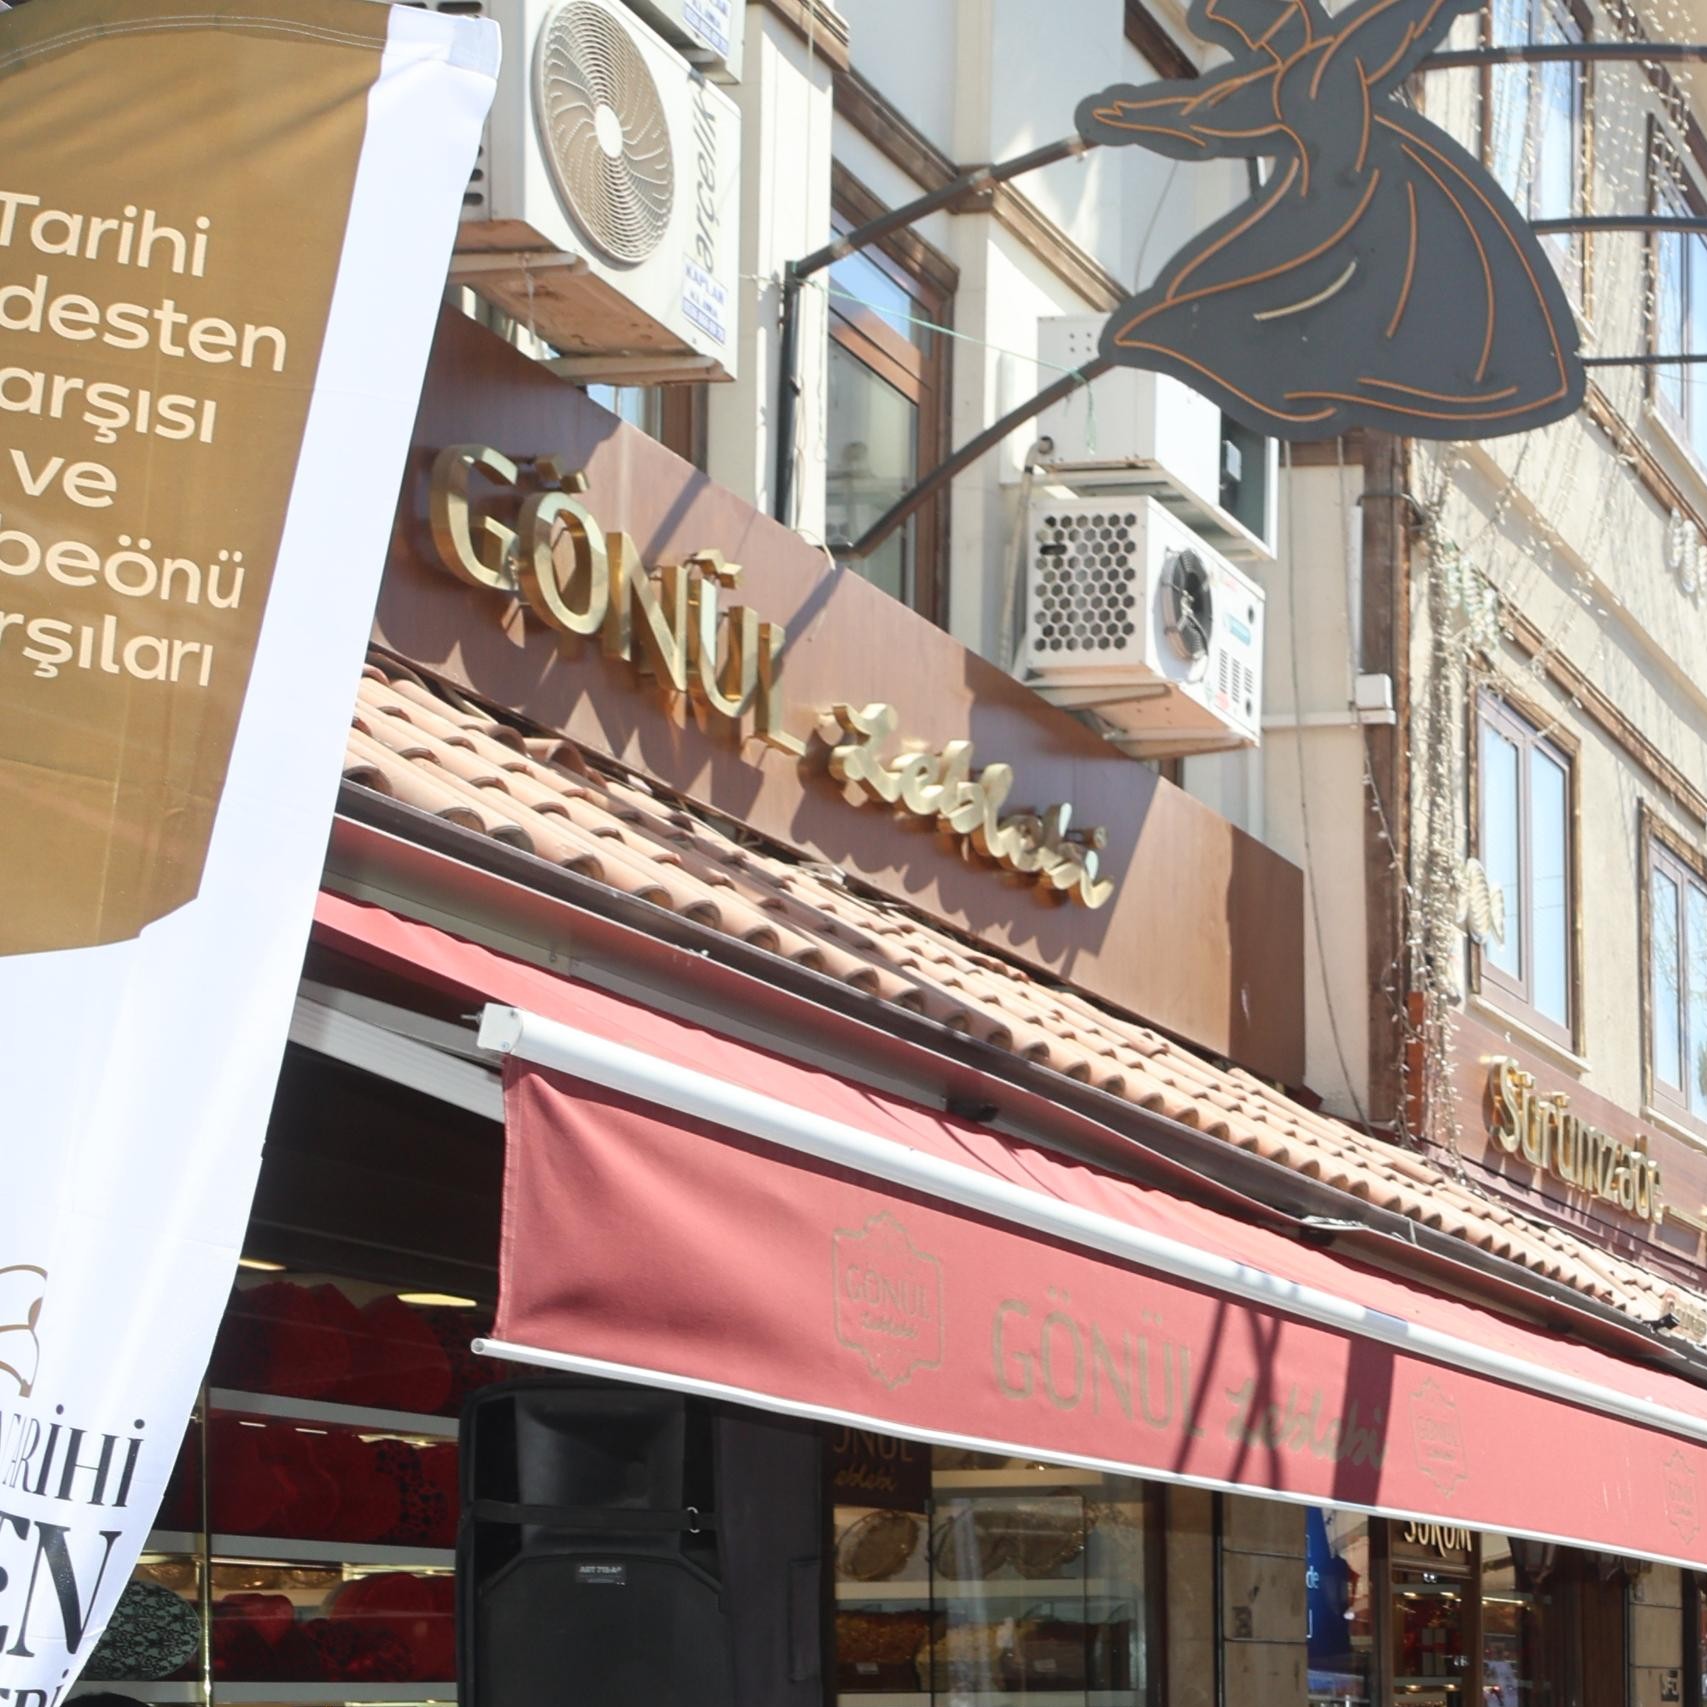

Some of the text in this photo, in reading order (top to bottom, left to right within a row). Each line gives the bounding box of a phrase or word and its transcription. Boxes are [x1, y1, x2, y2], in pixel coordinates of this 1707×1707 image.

[0, 191, 210, 277] Tarihi
[692, 84, 719, 274] arçelik
[10, 449, 117, 508] ve
[430, 443, 806, 758] GÖNÜL
[991, 1284, 1204, 1438] GÖNÜL
